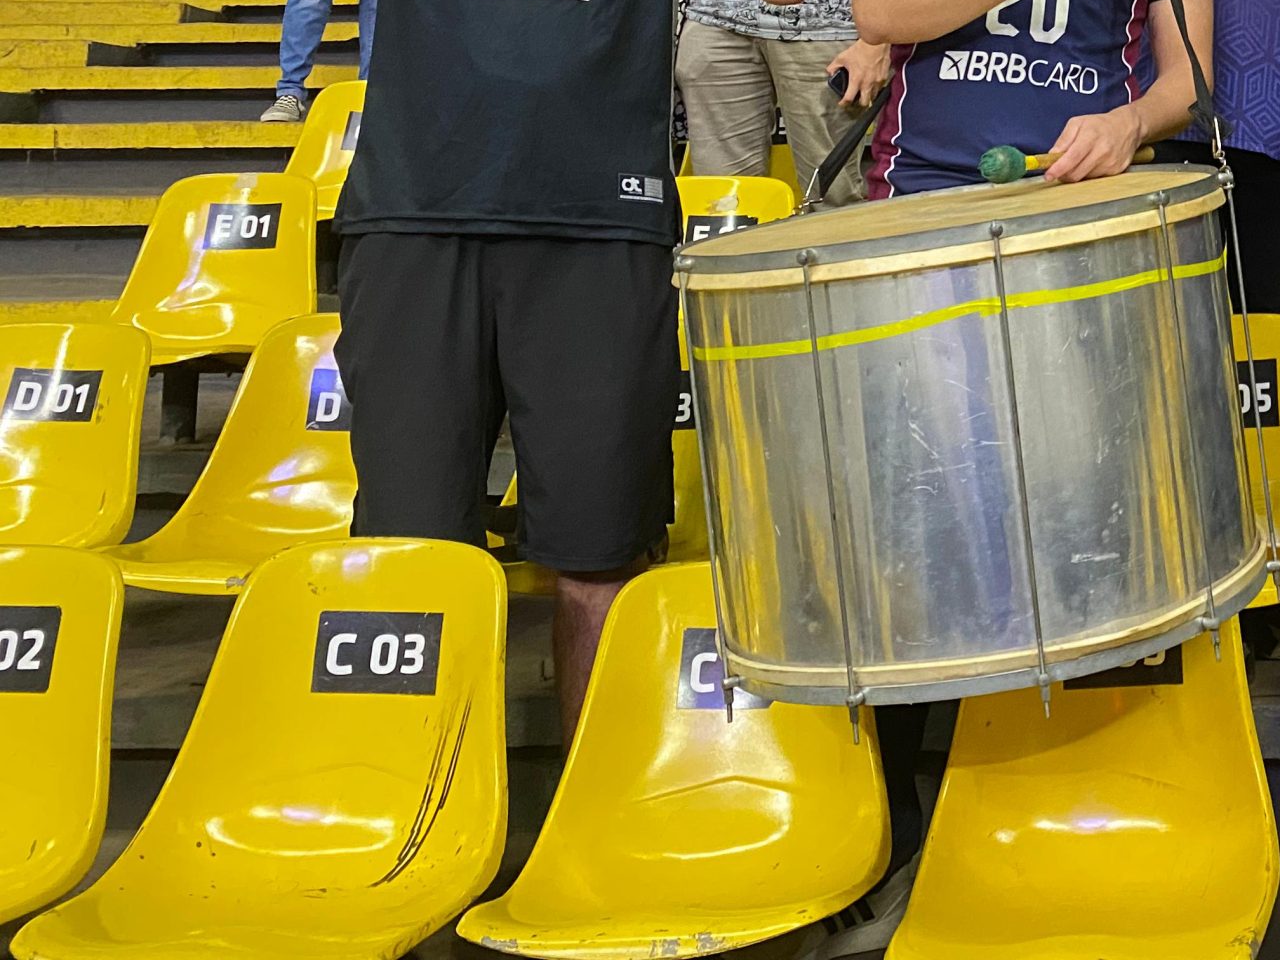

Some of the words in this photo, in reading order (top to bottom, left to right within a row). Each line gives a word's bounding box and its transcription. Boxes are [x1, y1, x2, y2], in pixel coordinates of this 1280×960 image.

[214, 214, 234, 238] E
[239, 214, 271, 238] 01
[13, 381, 43, 411] D
[53, 383, 90, 413] 01
[315, 392, 341, 422] D
[675, 393, 691, 422] 3
[0, 629, 45, 671] 02
[326, 633, 357, 675] C
[369, 633, 425, 676] 03
[689, 652, 718, 693] C
